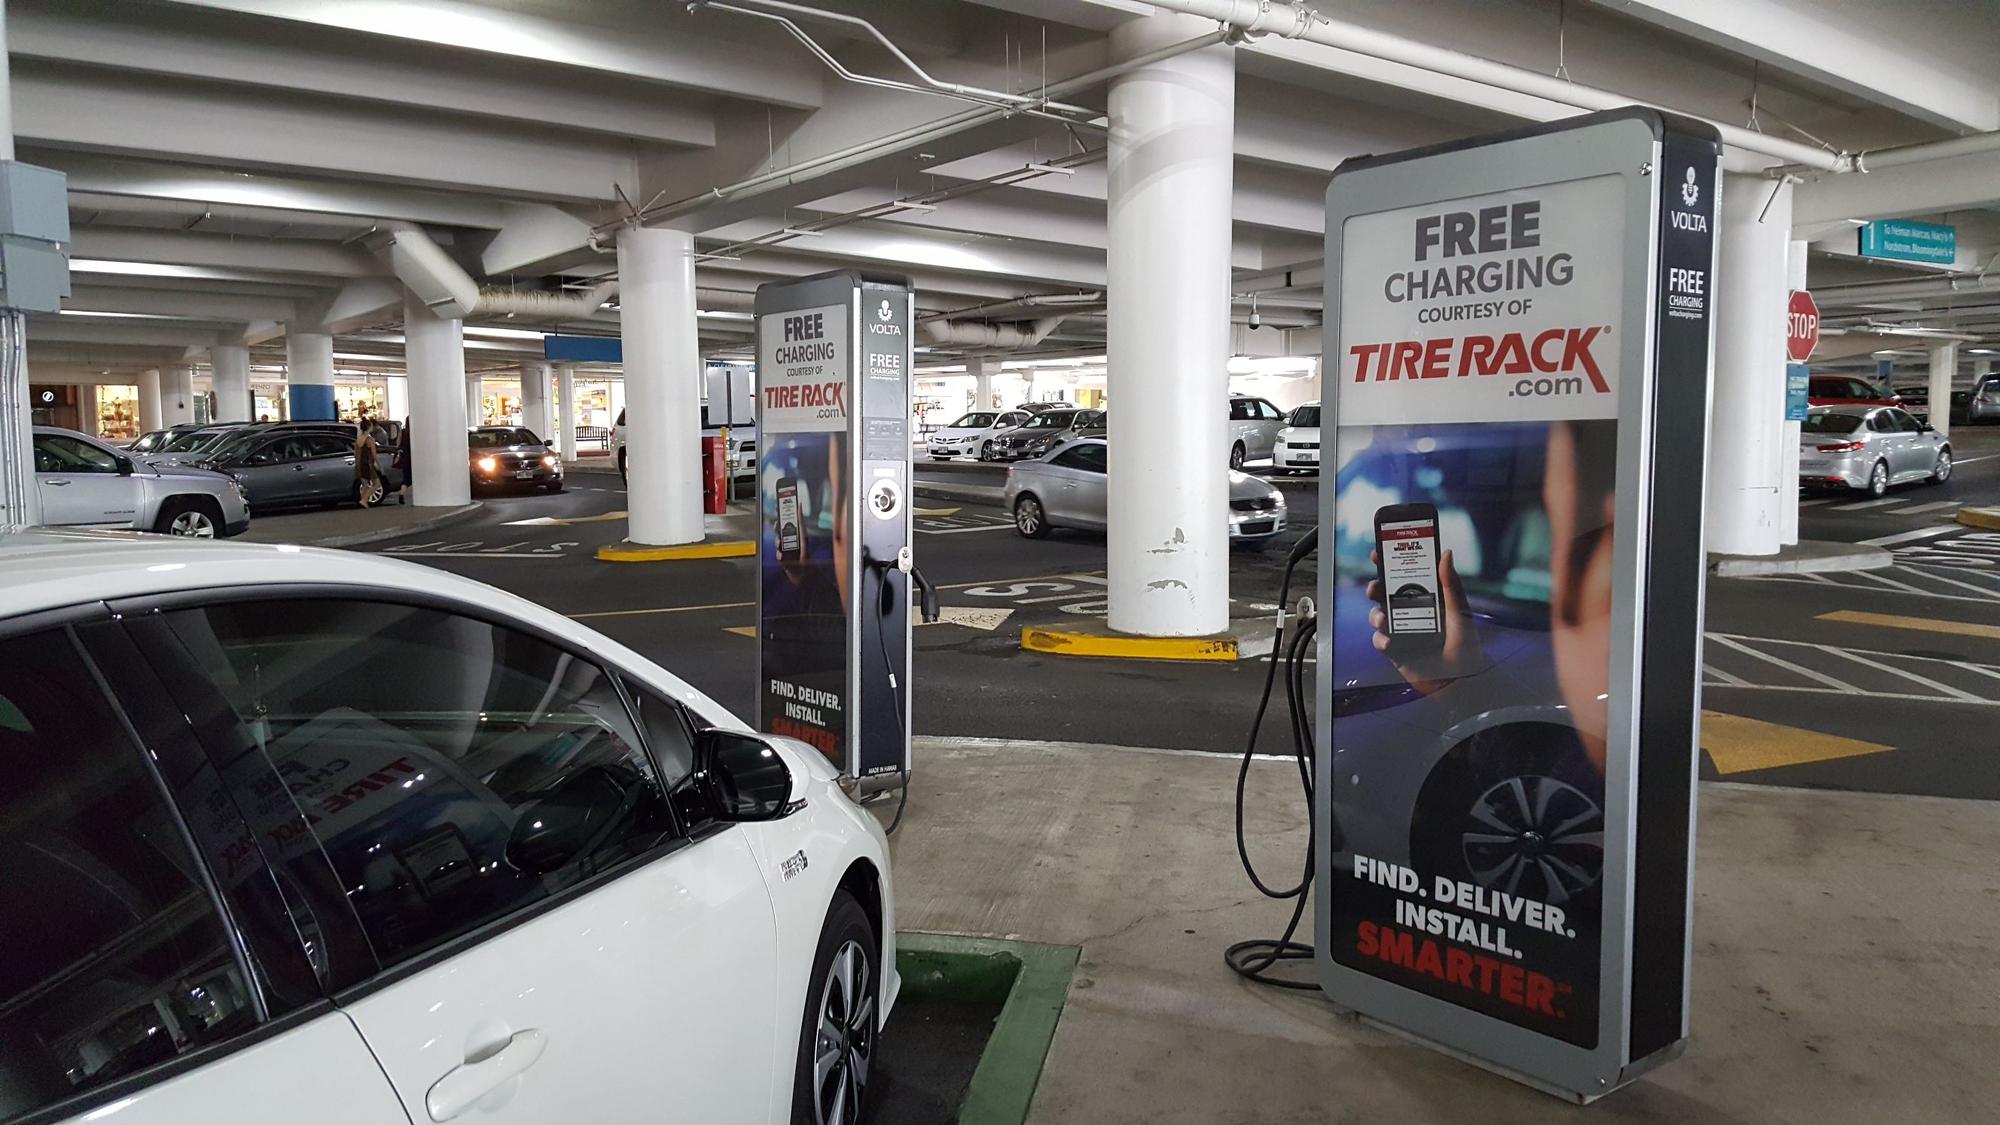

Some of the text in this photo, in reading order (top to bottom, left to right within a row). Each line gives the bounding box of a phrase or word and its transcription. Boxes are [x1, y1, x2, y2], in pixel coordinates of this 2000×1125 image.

[1415, 200, 1541, 262] FREE
[1671, 210, 1708, 233] VOLTA
[1384, 252, 1574, 303] CHARGING
[1669, 267, 1704, 295] FREE
[1418, 299, 1533, 324] COURTESY OF
[1669, 294, 1704, 309] CHARGING
[784, 312, 824, 343] FREE
[869, 323, 902, 336] VOLTA
[1787, 312, 1817, 340] STOP
[775, 342, 835, 365] CHARGING
[869, 353, 900, 369] FREE
[1350, 325, 1611, 394] TIRE RACK
[787, 365, 824, 377] COURTESY OF
[765, 382, 847, 418] TIRE RACK
[1508, 376, 1583, 397] .com
[816, 407, 839, 419] .com
[770, 679, 842, 712] FIND. DELIVER.
[785, 701, 826, 727] INSTALL.
[1353, 854, 1577, 939] FIND. DELIVER.
[1395, 899, 1523, 960] INSTALL.
[1356, 920, 1568, 1019] SMARTER.
